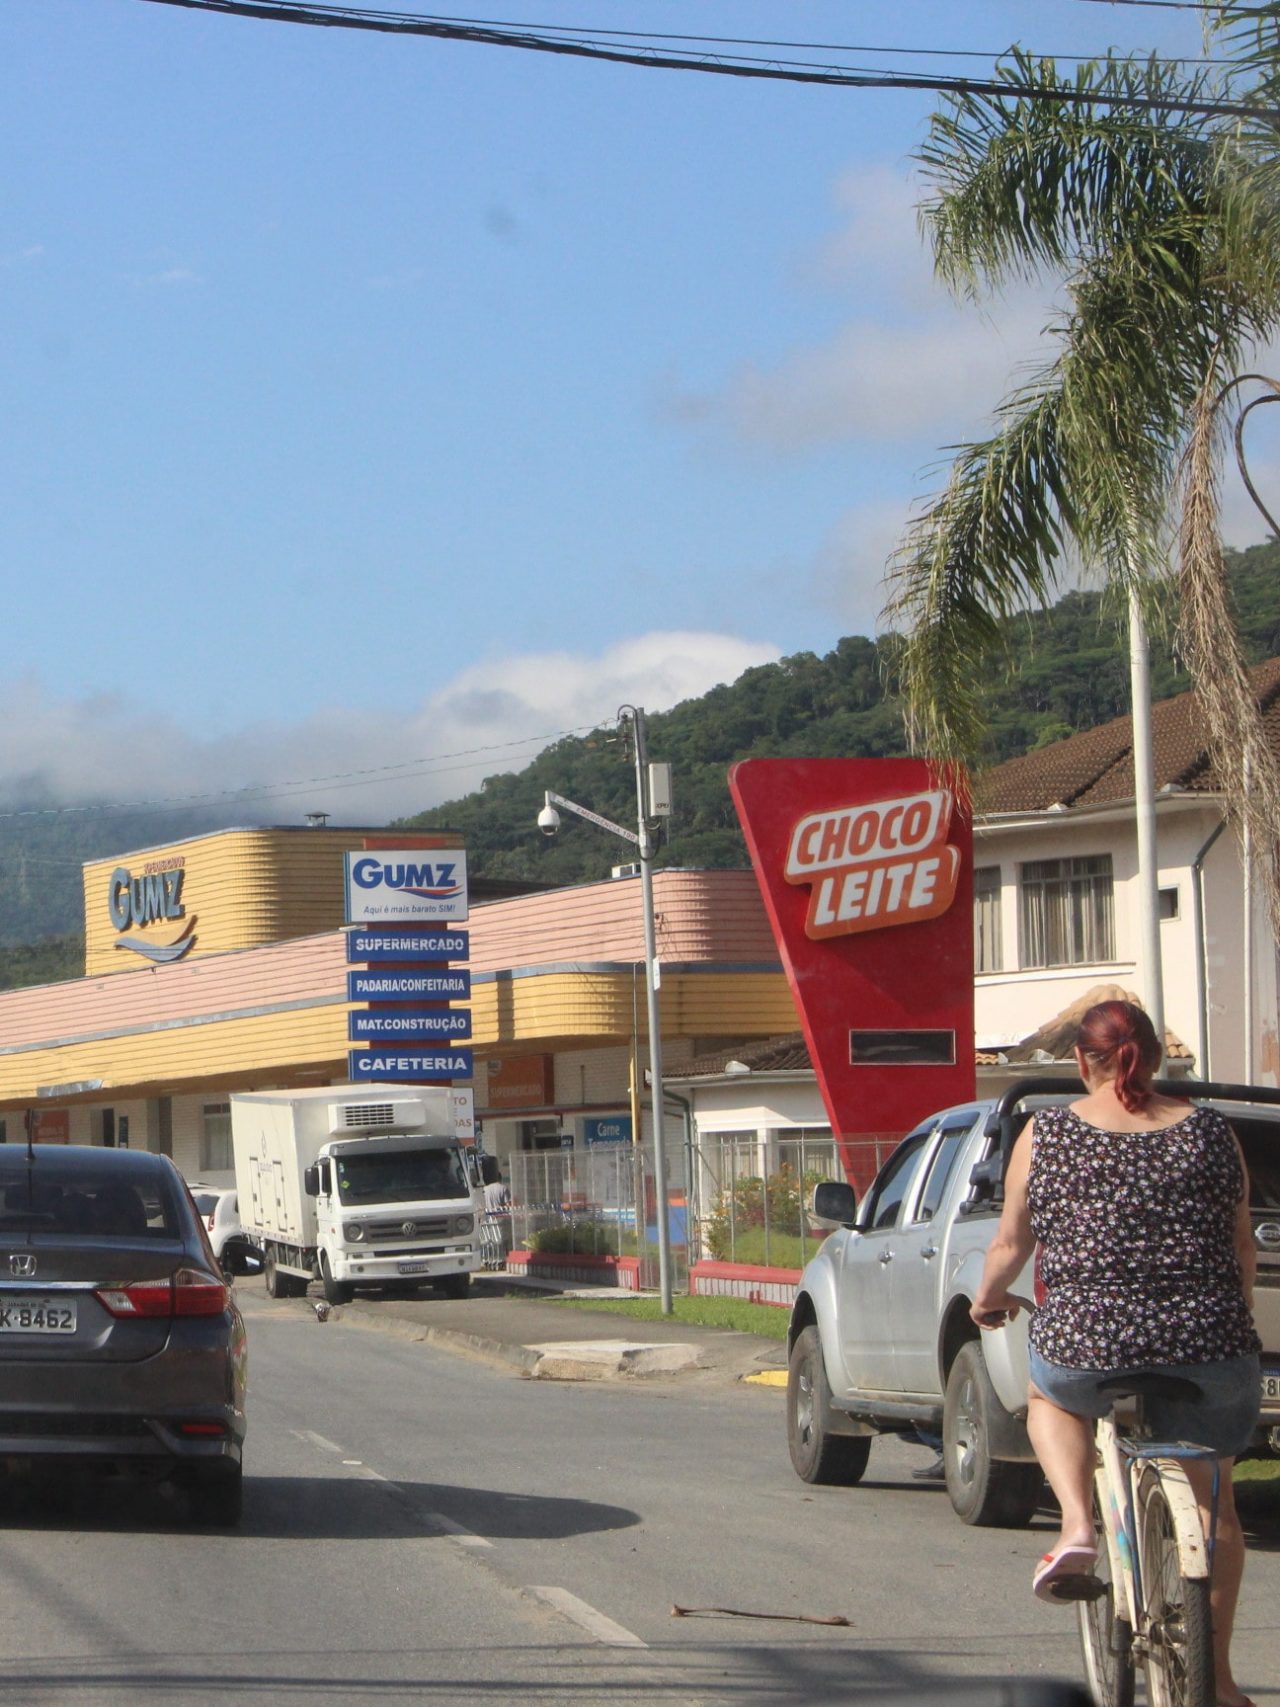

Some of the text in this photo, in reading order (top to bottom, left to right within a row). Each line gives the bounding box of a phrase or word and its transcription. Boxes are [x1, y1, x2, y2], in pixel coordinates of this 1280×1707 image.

[796, 800, 932, 865] CHOCO
[353, 858, 456, 889] GUMZ
[814, 858, 939, 925] LEITE
[364, 905, 383, 915] Aqui
[391, 905, 409, 913] mais
[411, 904, 436, 913] barato
[438, 904, 456, 913] SIM!
[356, 938, 464, 951] SUPERMERCADO
[356, 979, 465, 992] PADARIA/CONFEITARIA
[357, 1016, 466, 1032] MAT.CONSTRUÇÃO
[358, 1058, 467, 1071] CAFETERIA
[597, 1122, 620, 1136] Carne
